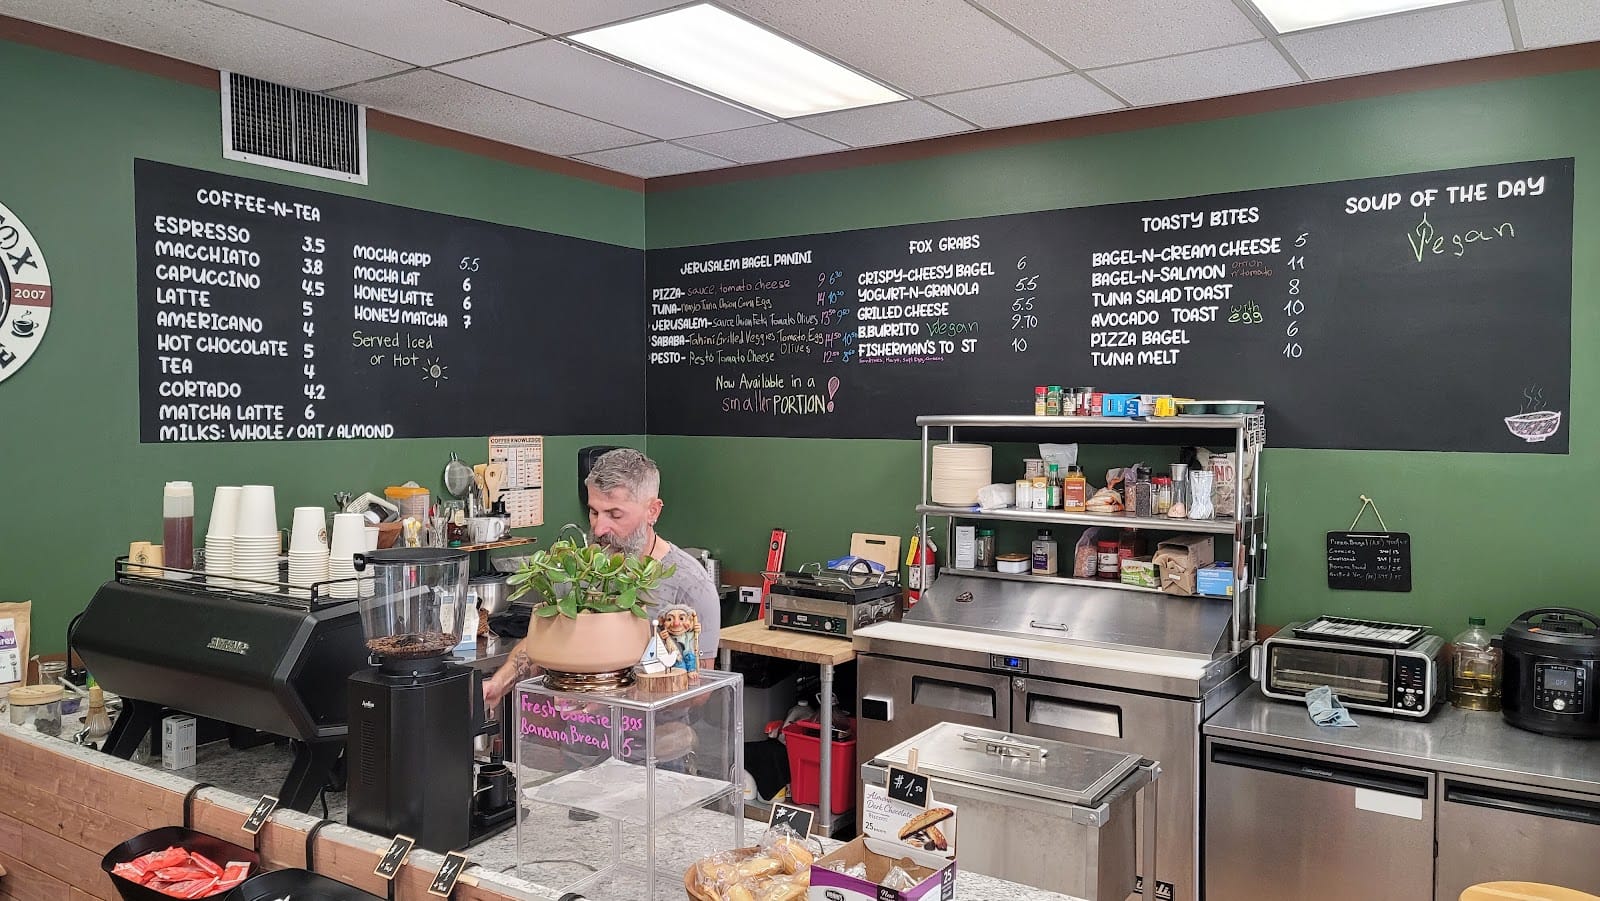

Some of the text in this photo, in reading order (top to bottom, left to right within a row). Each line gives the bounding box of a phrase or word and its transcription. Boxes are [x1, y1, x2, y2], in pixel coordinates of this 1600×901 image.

[197, 188, 320, 222] COFFEE-N-TEA
[1345, 176, 1545, 214] SOUP OF THE DAY
[1142, 207, 1259, 233] TOASTY BITES
[0, 214, 38, 275] OX
[154, 215, 325, 253] ESPRESSO 3.5
[909, 234, 980, 254] FOX GRABS
[1407, 218, 1515, 263] Vegan
[155, 240, 323, 275] MACCHIATO 3.8
[353, 244, 480, 272] MOCHA CAPP 5.5
[680, 250, 812, 275] JERUSALEM BAGEL PANINI
[1092, 232, 1309, 268] BAGEL-N-CREAM CHEESE 5
[156, 264, 260, 289] CAPUCCINO
[354, 266, 472, 292] MOCHA LAT 6
[720, 279, 752, 293] tomato
[754, 279, 792, 290] cheese
[818, 272, 826, 288] 9
[858, 256, 1027, 286] CRISPY-CHEESY BAGEL 6
[1092, 256, 1305, 287] BAGEL-N-SALMON 11
[14, 288, 46, 300] 2007
[354, 284, 472, 310] HONEY LATTE 6
[858, 274, 1040, 302] YOGURT-N-GRANOLA 5.5
[1092, 278, 1300, 308] TUNA SALAD TOAST 8
[157, 287, 313, 317] LATTE 5
[755, 296, 772, 310] Egg
[857, 296, 1036, 320] GRILLED CHEESE 5.5
[1091, 300, 1305, 328] AVOCADO TOAST 10
[1230, 300, 1260, 313] with
[157, 311, 314, 337] AMERICANO 4
[354, 305, 472, 328] HONEY MATCHA 7
[712, 318, 735, 328] sauce
[796, 312, 818, 326] Olives
[858, 322, 920, 339] B.BURRITO
[1010, 314, 1038, 330] 9.70
[1228, 312, 1264, 324] egg
[158, 334, 314, 359] HOT CHOCOLATE 5
[352, 330, 434, 350] Served Iced
[688, 332, 716, 346] Tahini
[716, 330, 744, 346] Grilled
[808, 327, 824, 345] Egg
[858, 337, 1028, 357] FISHERMAN'S TO ST 10
[1090, 321, 1299, 348] PIZZA BAGEL 6
[370, 352, 420, 367] or Hot
[688, 348, 715, 366] Pesto
[716, 348, 746, 365] Tomato
[747, 348, 775, 363] Cheese
[780, 343, 811, 355] Olives
[1090, 342, 1303, 366] TUNA MELT 10
[158, 356, 315, 379] TEA 4
[159, 381, 242, 398] CORTADO
[716, 372, 816, 392] Now Available in a
[160, 404, 315, 421] MATCHA LATTE 6
[722, 389, 772, 414] smaller
[159, 424, 225, 441] MILKS:
[230, 424, 284, 440] WHOLE
[297, 424, 325, 439] OAT
[336, 423, 394, 439] ALMOND
[0, 637, 16, 645] rey
[521, 694, 612, 729] Fresh Cookie
[520, 716, 610, 750] Banana Bread
[867, 800, 912, 818] Dark Chocolate
[865, 822, 874, 830] 25
[942, 868, 952, 884] 25
